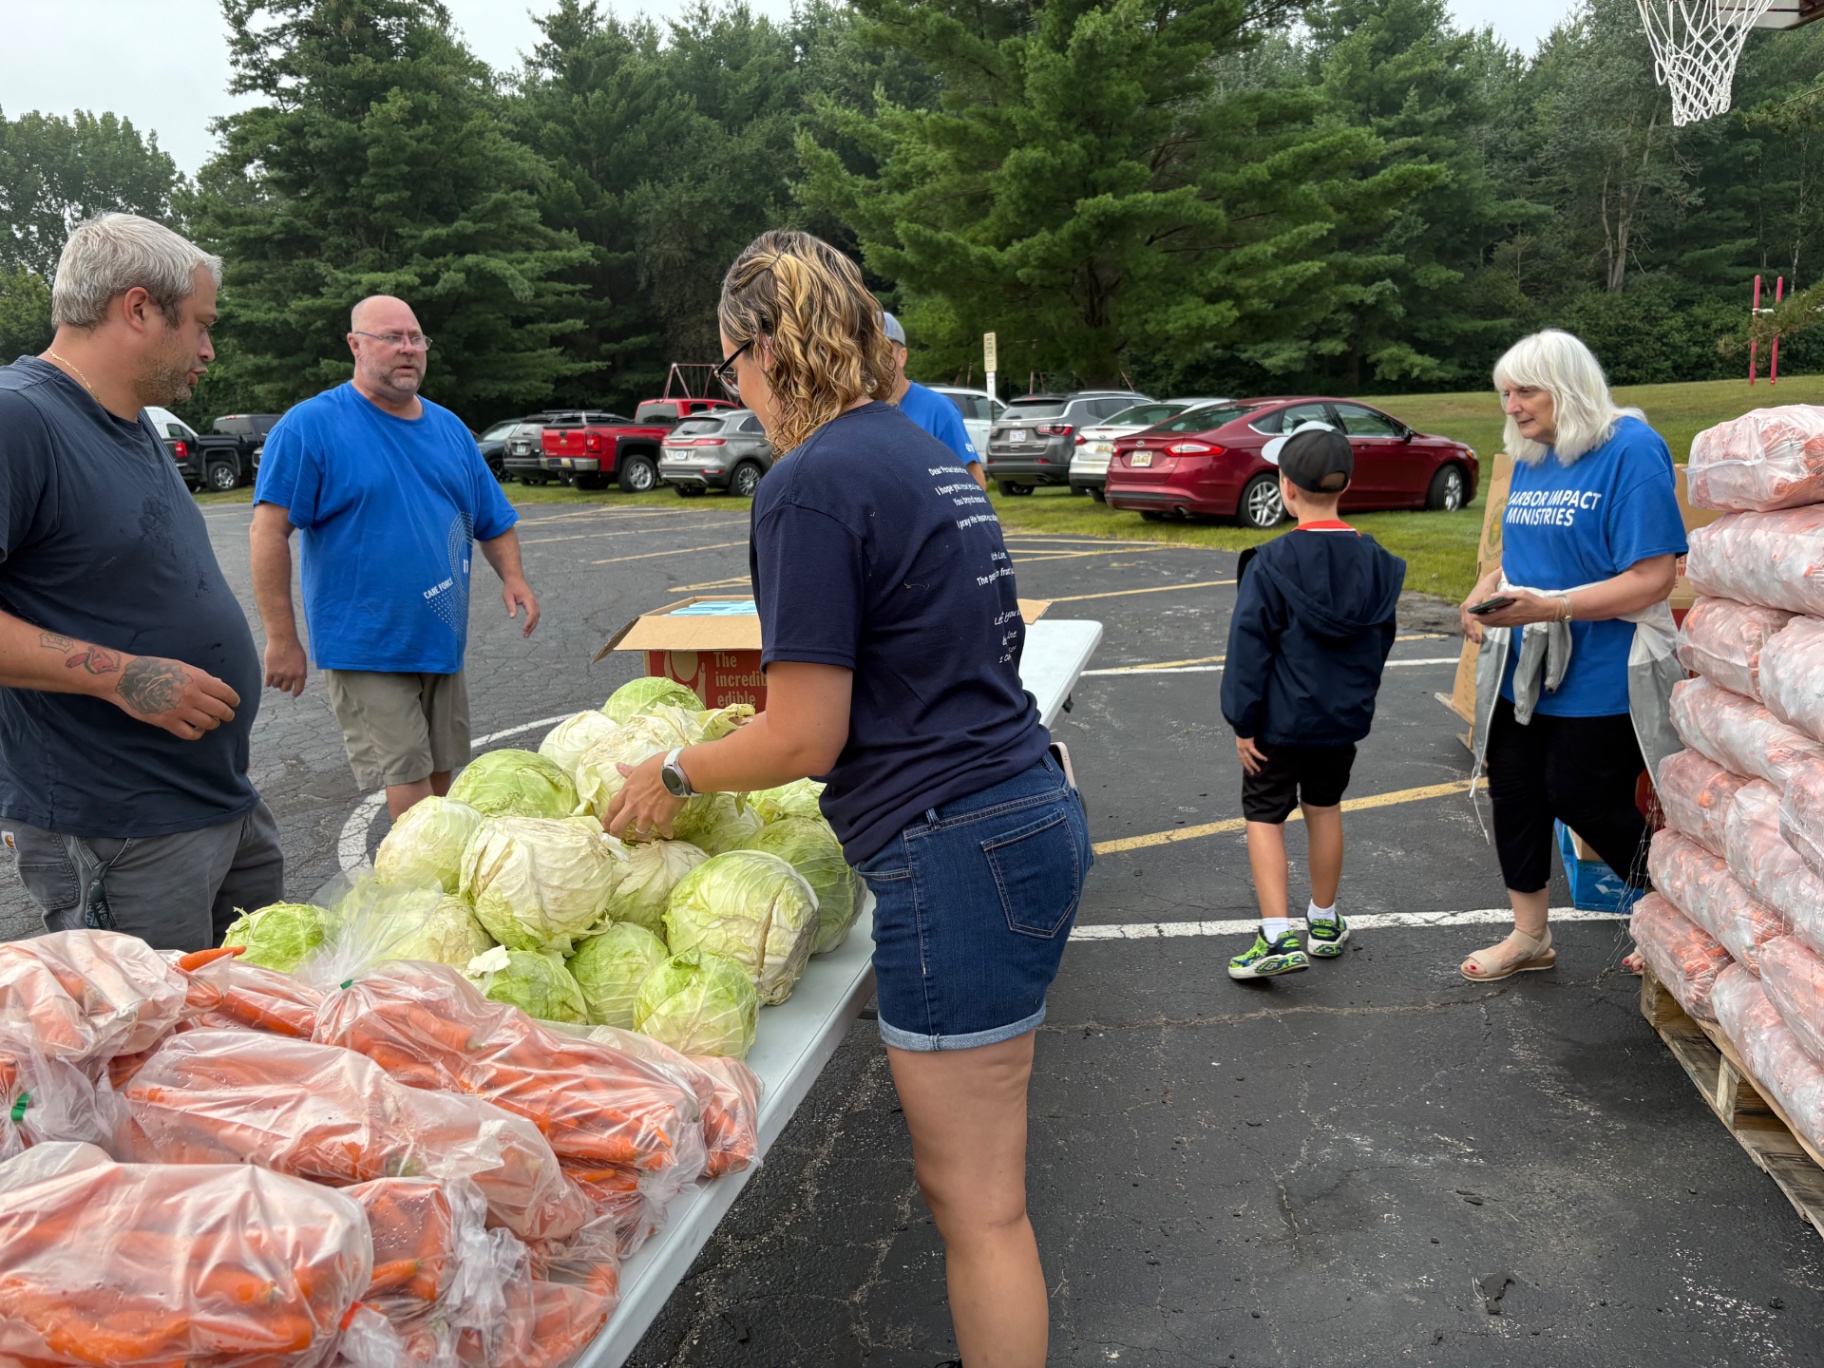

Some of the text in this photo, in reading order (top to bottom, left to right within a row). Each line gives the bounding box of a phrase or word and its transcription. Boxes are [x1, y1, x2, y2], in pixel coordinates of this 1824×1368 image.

[928, 466, 942, 476] Dear
[938, 485, 954, 495] hope
[1546, 490, 1602, 510] IMPACT
[959, 518, 972, 530] pray
[1506, 507, 1575, 526] MINISTRIES
[976, 576, 989, 586] The
[423, 585, 440, 600] CARE
[713, 651, 738, 668] The
[717, 690, 756, 707] edible
